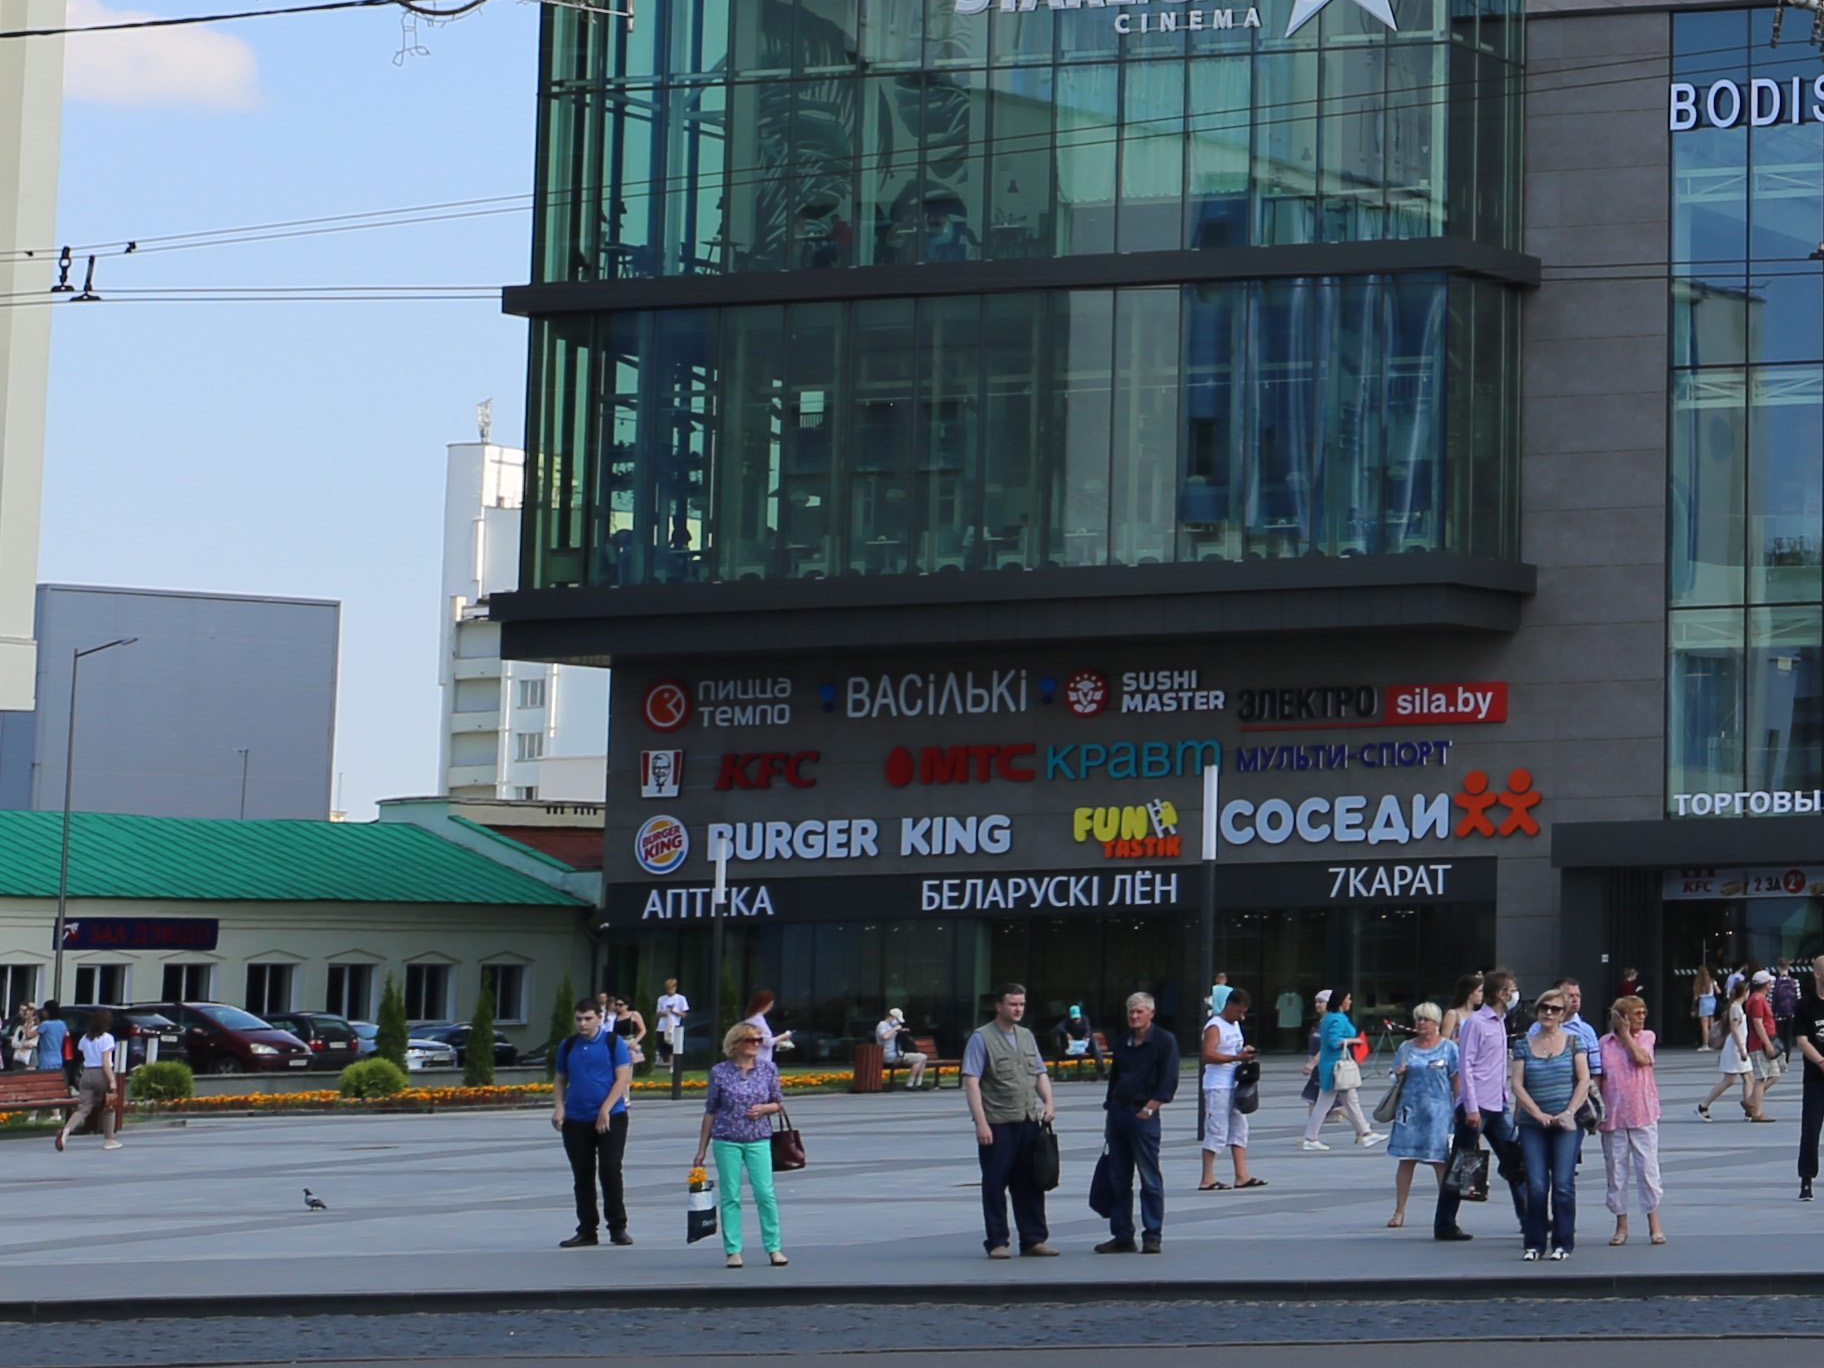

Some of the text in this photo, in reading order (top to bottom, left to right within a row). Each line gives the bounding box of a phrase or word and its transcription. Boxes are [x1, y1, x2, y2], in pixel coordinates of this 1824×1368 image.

[1115, 7, 1262, 34] CINEMA
[1122, 670, 1198, 692] SUSHI
[1120, 689, 1226, 713] MASTER
[1236, 685, 1378, 722] ЭЛЕКТРО
[1395, 686, 1494, 719] sila.by
[714, 749, 821, 790] KFC
[919, 743, 1037, 784] МТС
[1236, 740, 1453, 772] МУЛЬТИ-СПОРТ
[1073, 805, 1149, 843] FUN
[1220, 793, 1450, 845] СОСЕДИ
[644, 834, 683, 862] KING
[707, 814, 1012, 862] BURGER KING
[1102, 836, 1182, 859] TASTIK
[922, 870, 1178, 912] БЕЛАРУСКІ ЛЁН
[1328, 864, 1453, 898] 7КАРАТ
[1682, 880, 1713, 893] KFC
[88, 924, 211, 944] ЗАЛ ДЗЮДО
